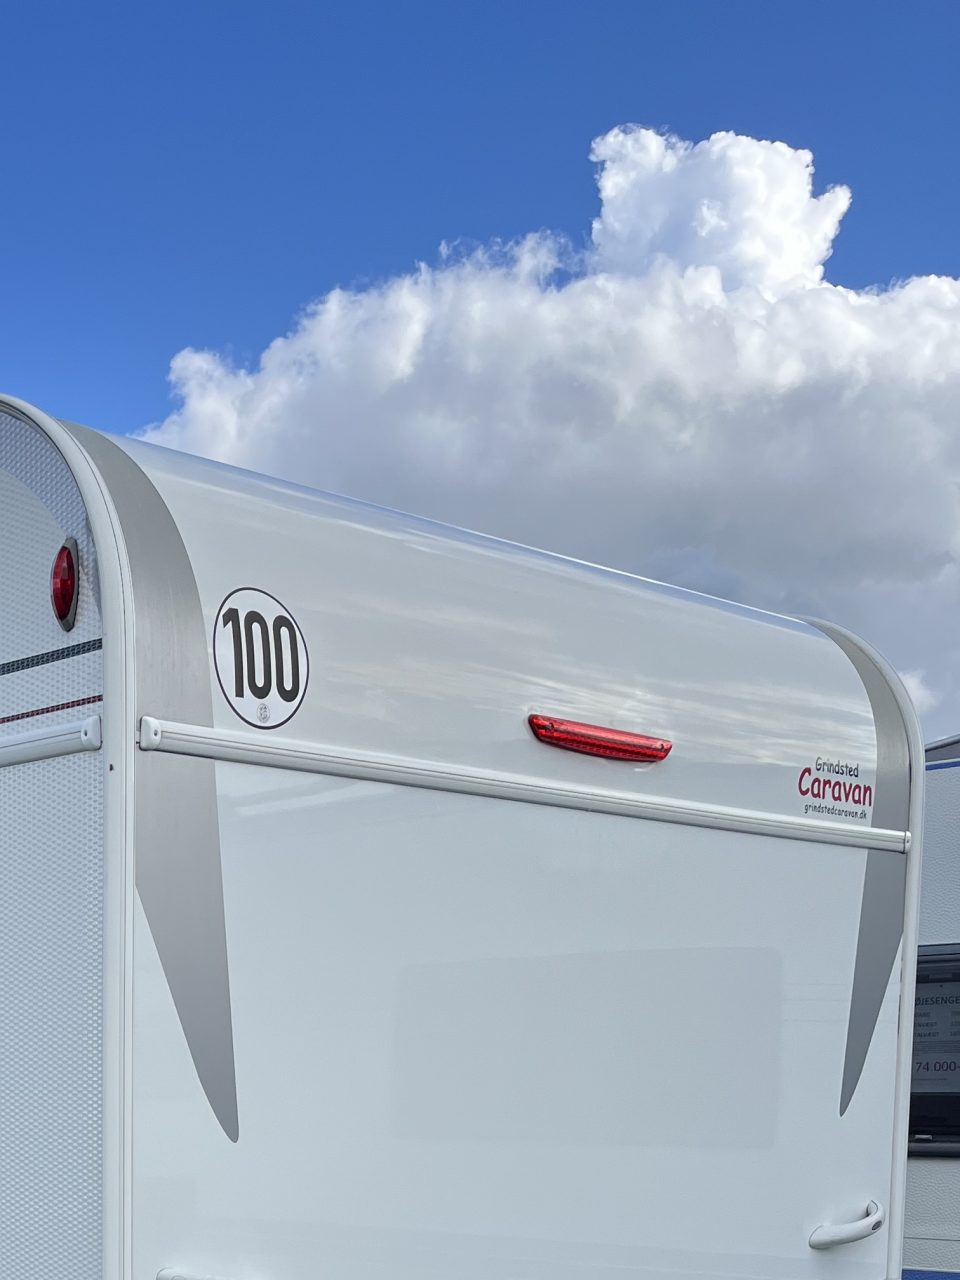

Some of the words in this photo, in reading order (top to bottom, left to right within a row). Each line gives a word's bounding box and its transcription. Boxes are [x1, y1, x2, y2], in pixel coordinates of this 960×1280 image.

[222, 607, 300, 703] 100
[815, 756, 859, 778] Grindsted
[798, 767, 872, 807] Caravan
[804, 802, 867, 819] grindstedcaravan.dk
